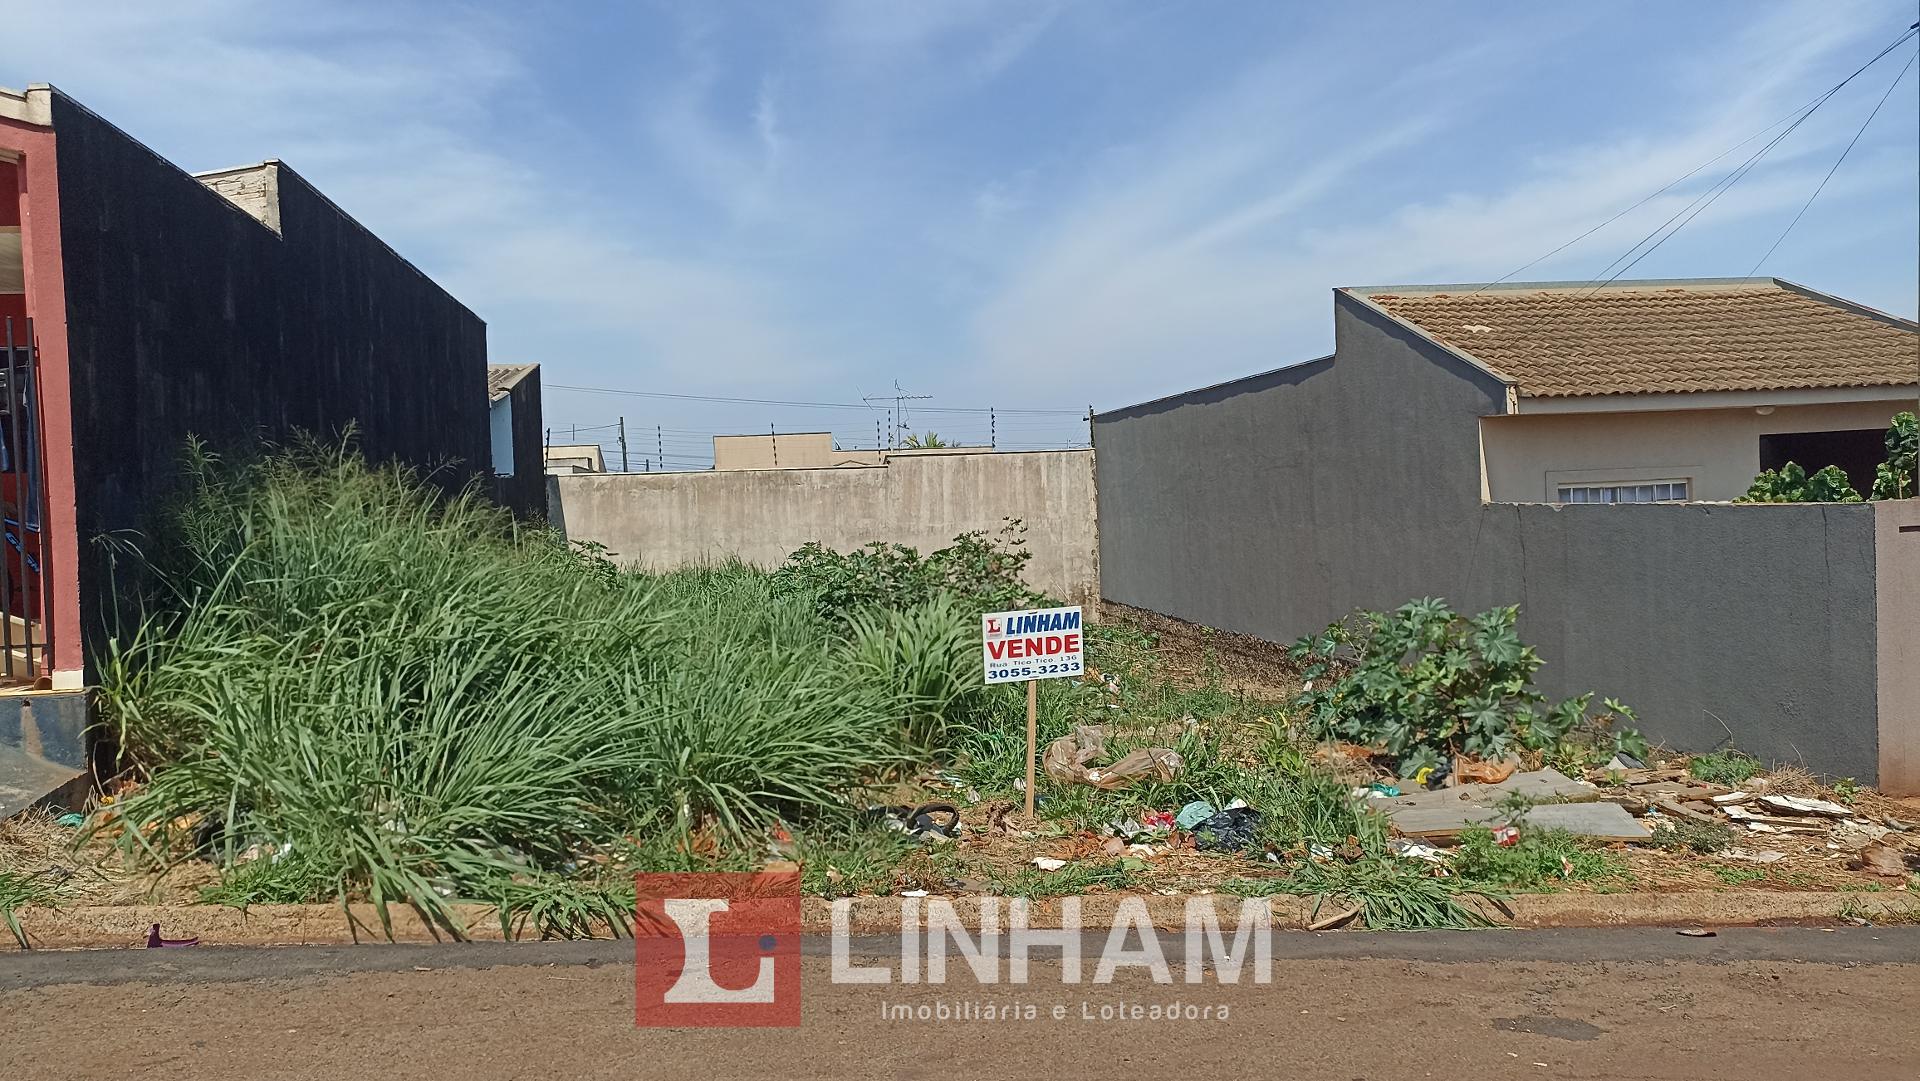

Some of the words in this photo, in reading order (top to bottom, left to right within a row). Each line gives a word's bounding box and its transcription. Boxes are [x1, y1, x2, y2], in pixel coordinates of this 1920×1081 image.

[1006, 612, 1080, 635] LINHAM
[987, 634, 1080, 660] VENDE
[988, 662, 1080, 679] 3055-3233
